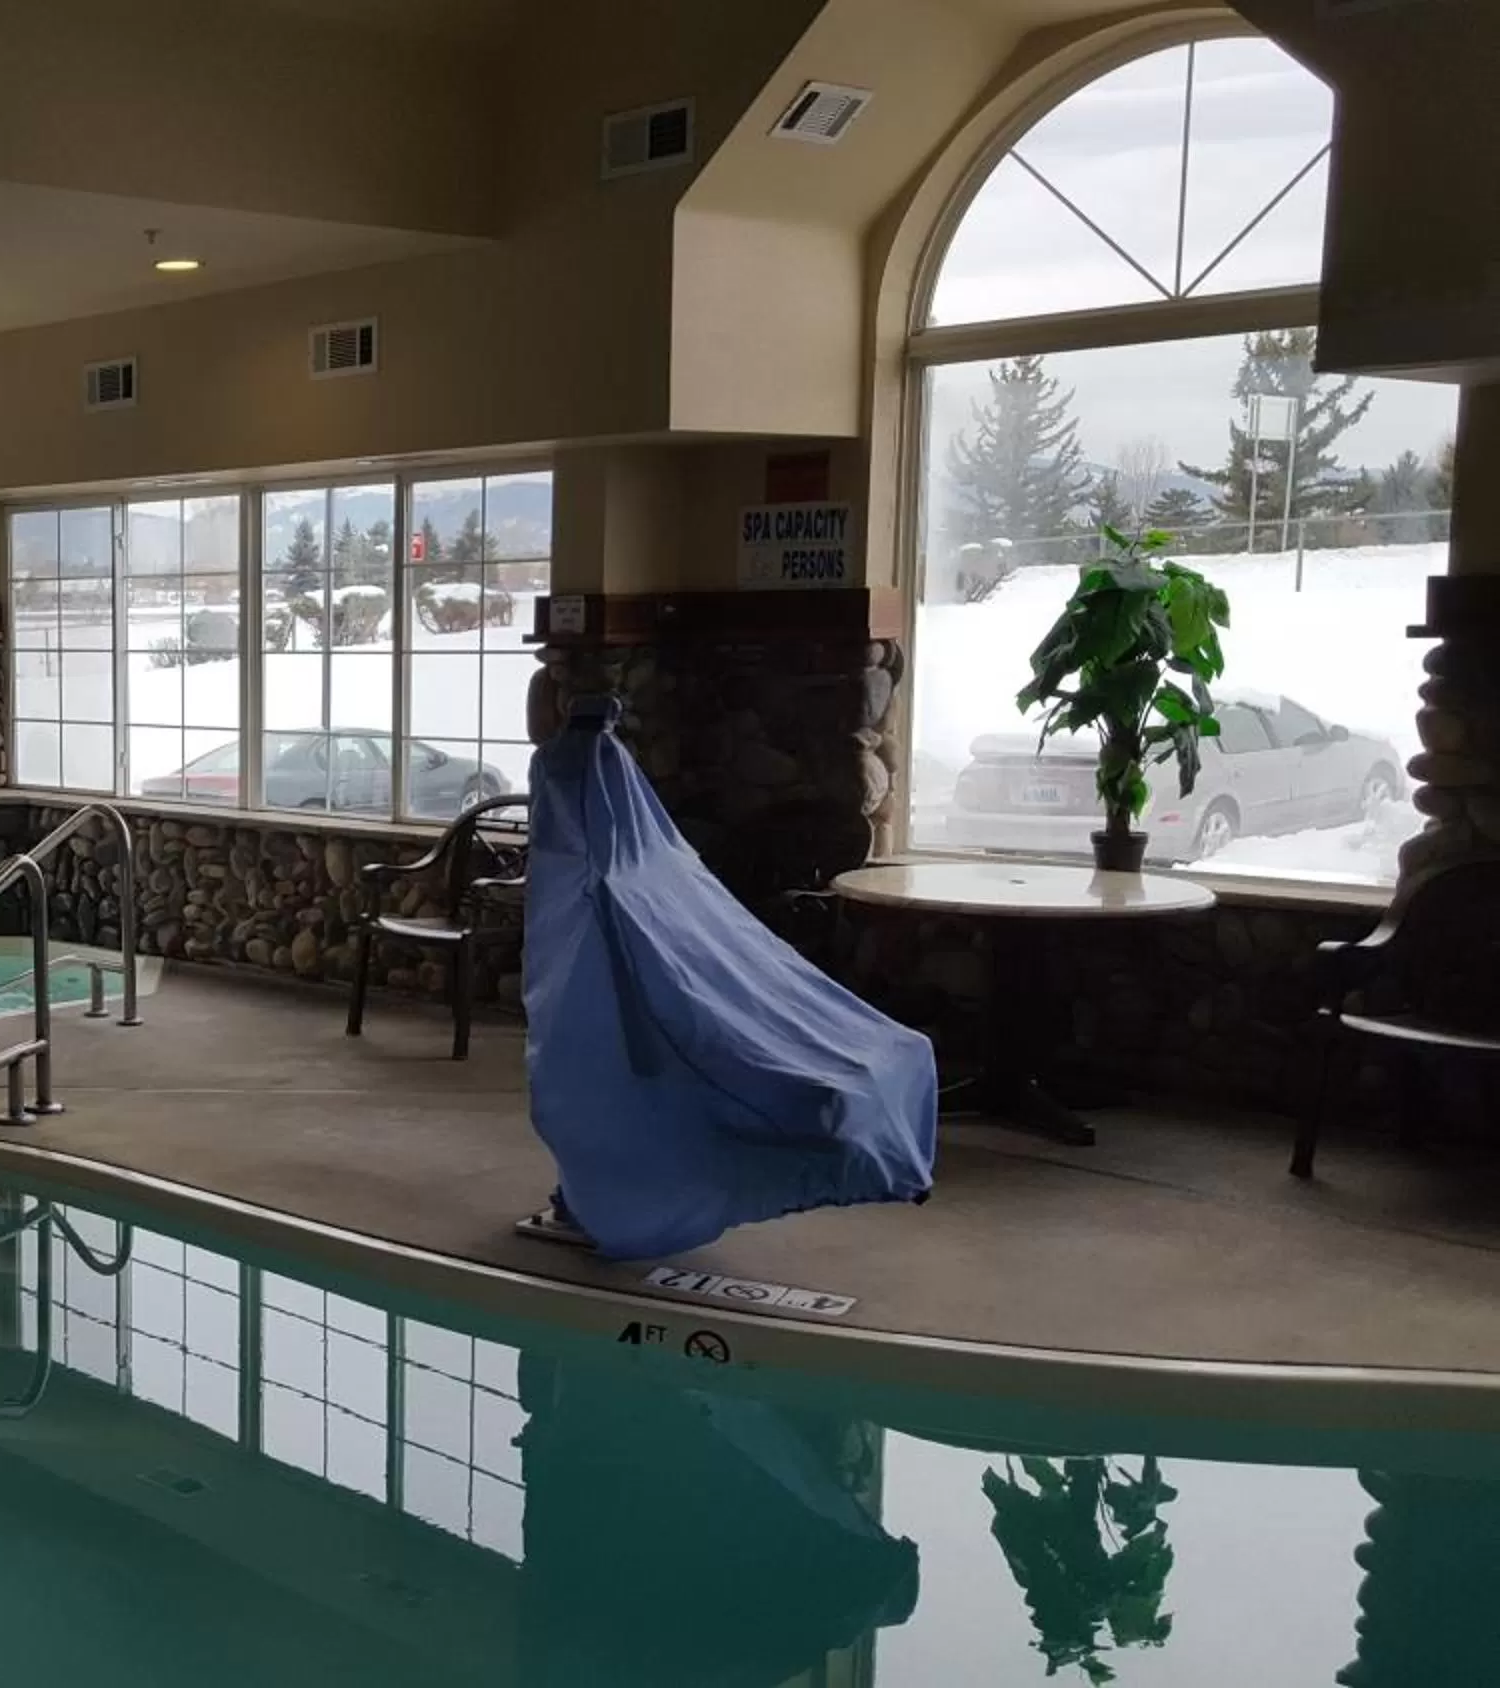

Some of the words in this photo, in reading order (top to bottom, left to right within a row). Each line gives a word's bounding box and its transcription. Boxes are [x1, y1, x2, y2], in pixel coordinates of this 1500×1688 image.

[743, 511, 770, 541] SPA
[776, 508, 848, 540] CAPACITY
[782, 548, 844, 579] PERSONS
[646, 1324, 667, 1342] FT
